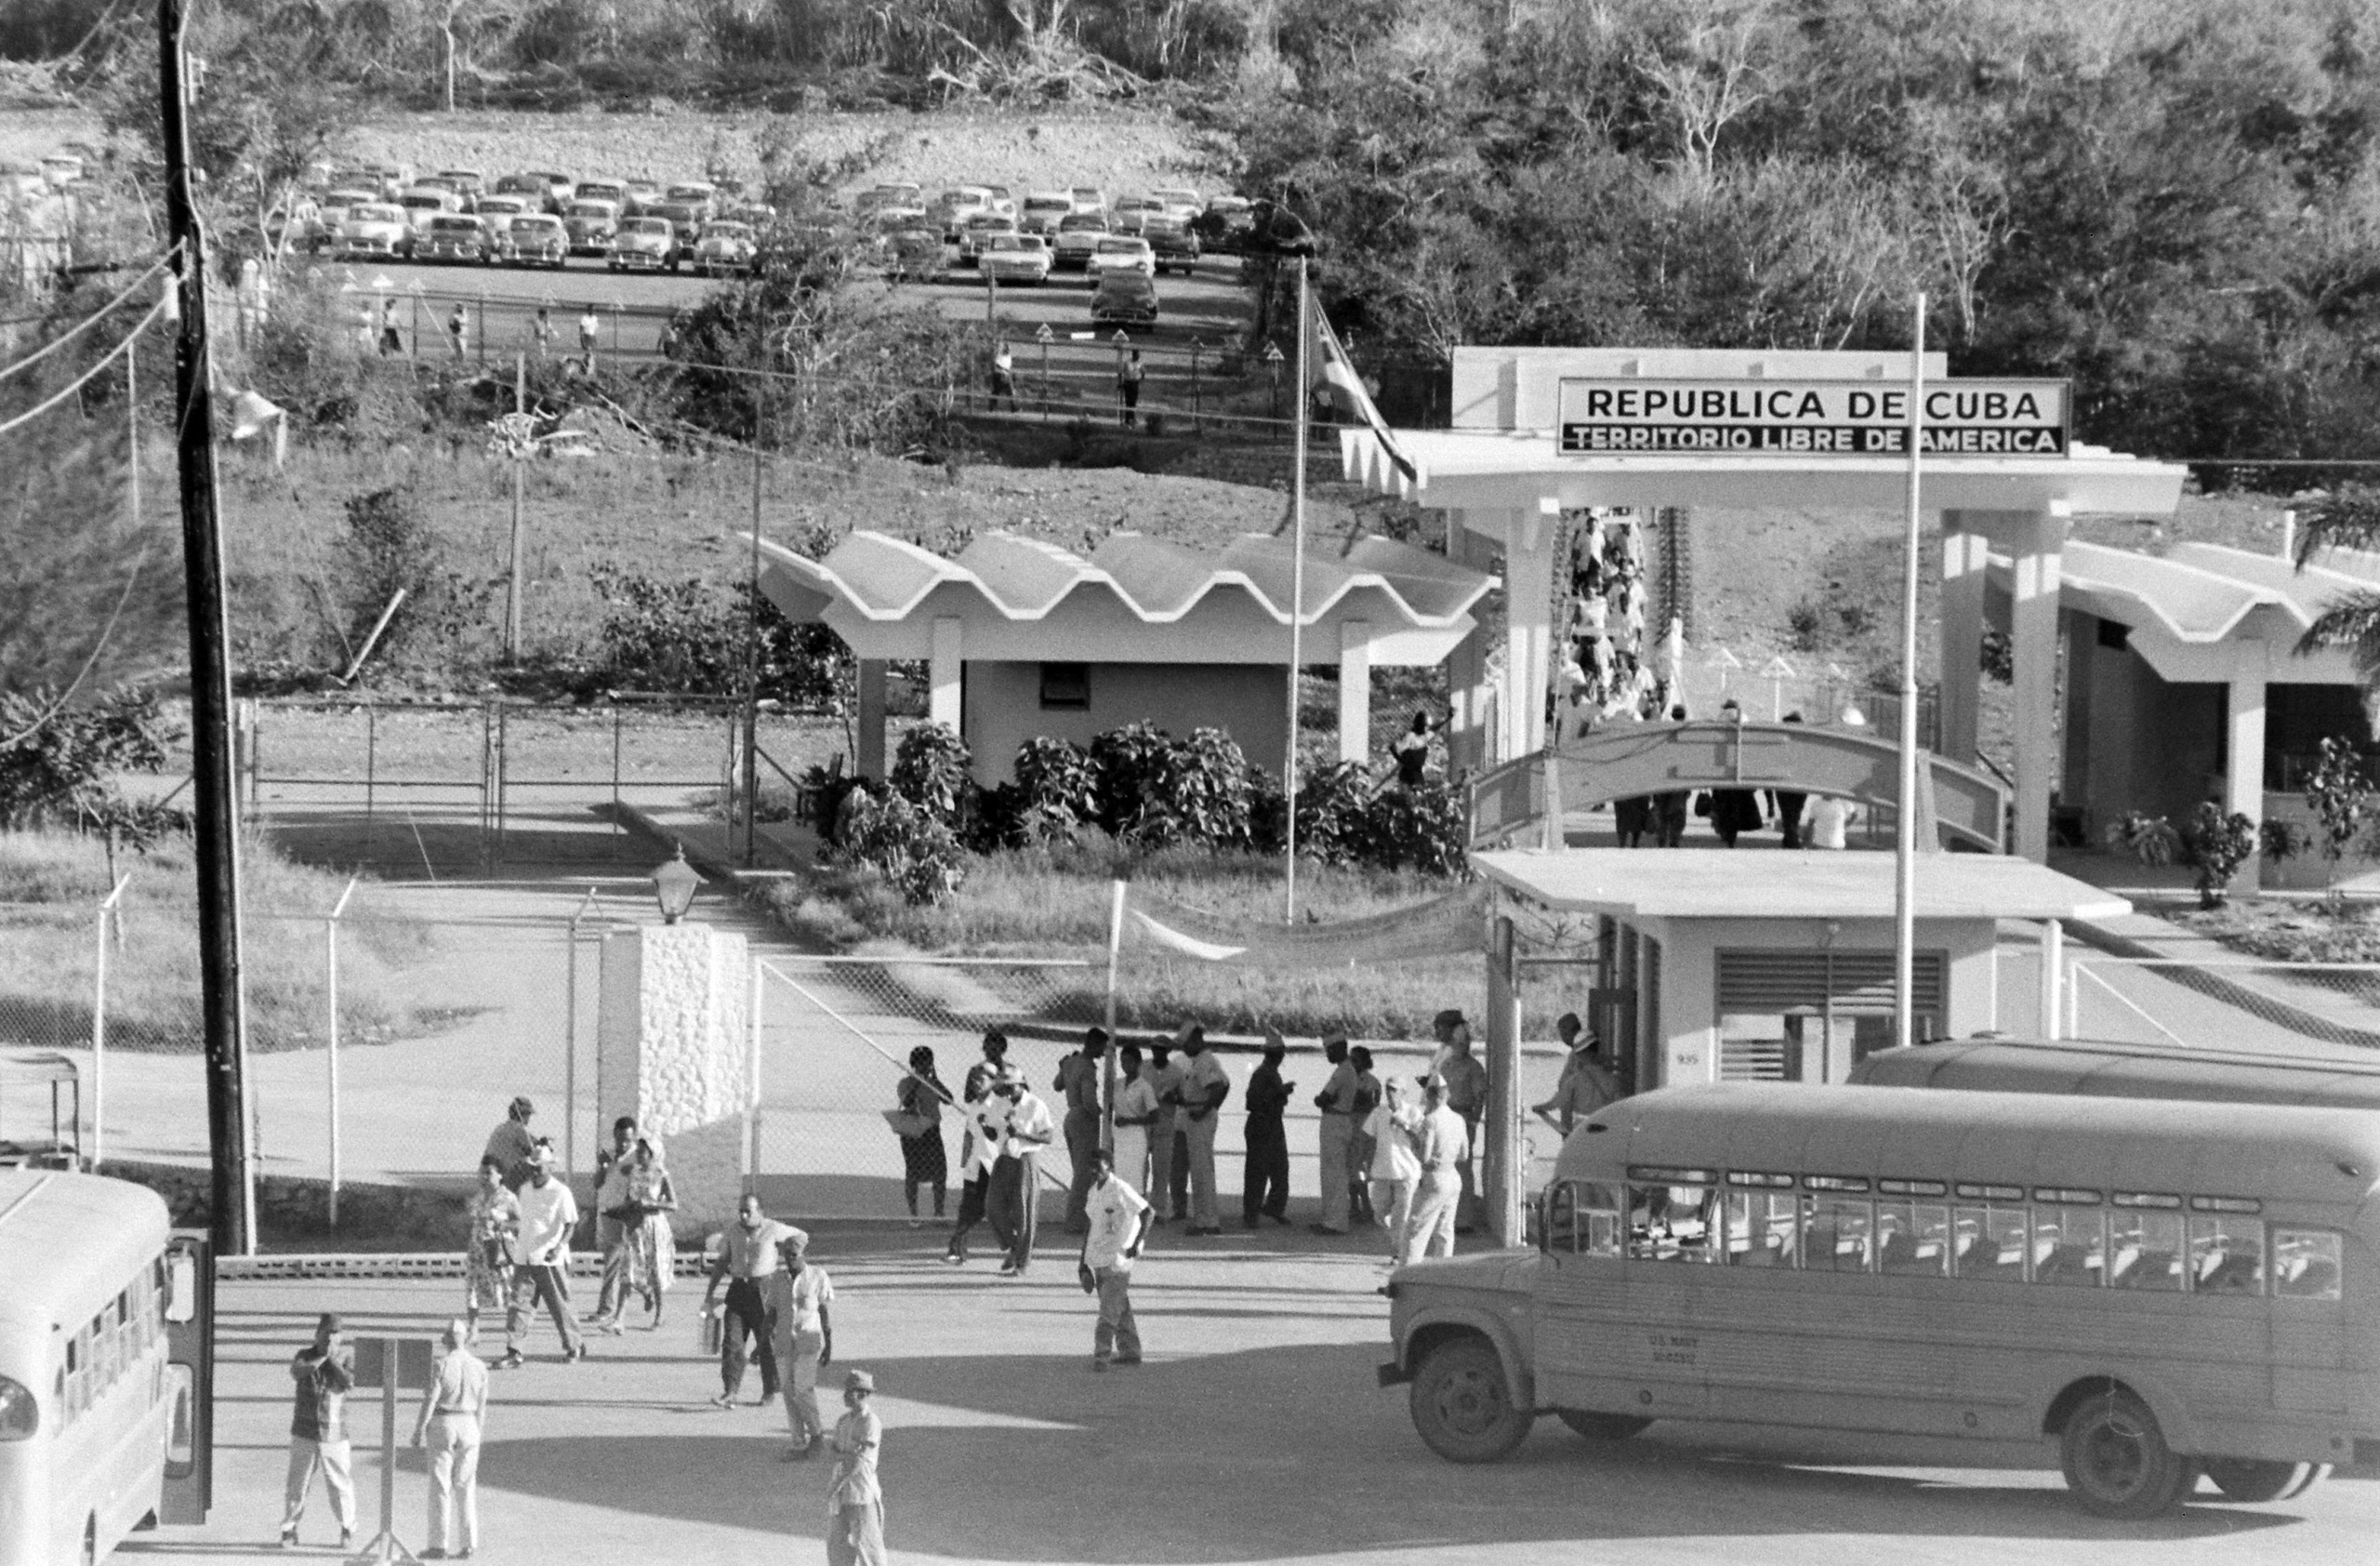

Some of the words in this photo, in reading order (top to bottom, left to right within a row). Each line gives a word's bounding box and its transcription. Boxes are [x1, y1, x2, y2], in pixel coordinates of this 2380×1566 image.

[1588, 389, 1826, 418] REPUBLICA
[1848, 391, 1906, 419] DE
[1924, 392, 2042, 420] CUBA
[1572, 426, 1752, 450] TERRITORIO
[1762, 427, 1855, 451] LIBRE
[1865, 429, 1903, 452] DE
[1920, 429, 2058, 453] AMERICA
